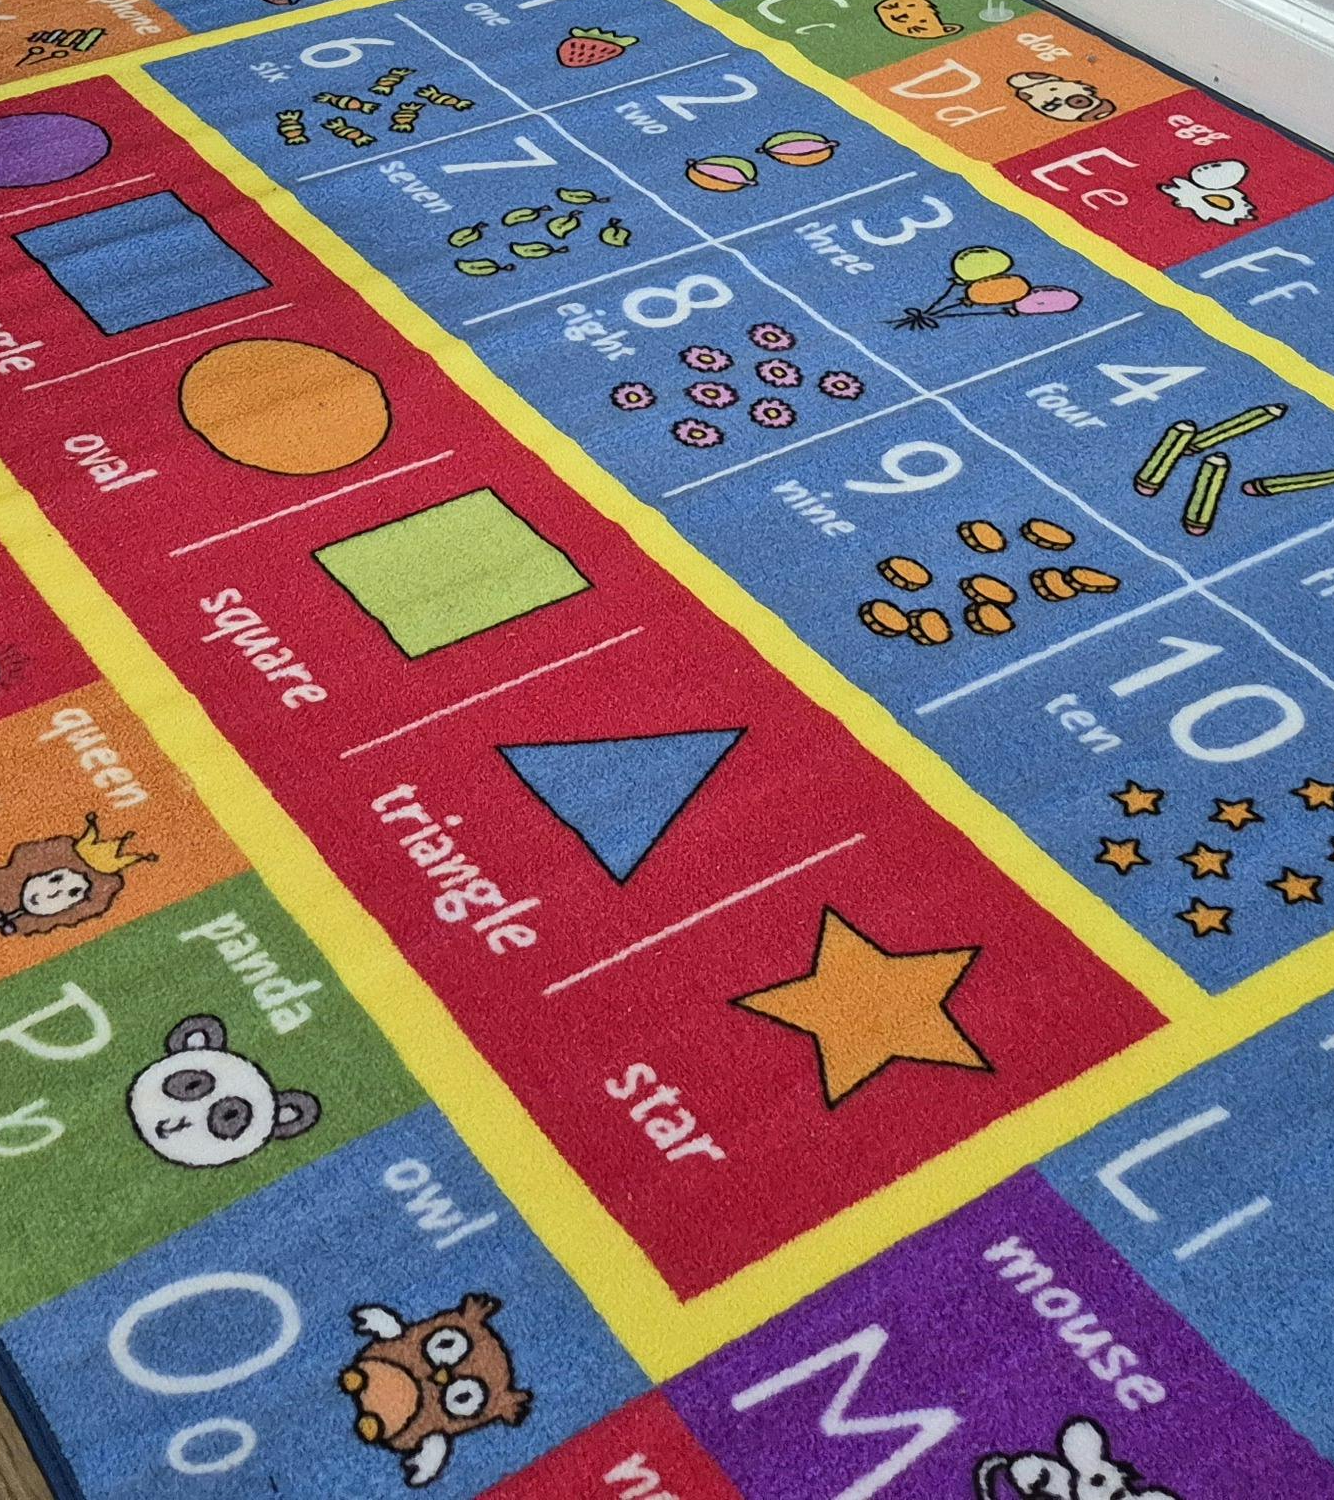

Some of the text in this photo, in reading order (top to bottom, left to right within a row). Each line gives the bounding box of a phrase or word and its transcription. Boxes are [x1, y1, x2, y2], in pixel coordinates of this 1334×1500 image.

[464, 1, 510, 28] one
[1015, 32, 1072, 63] dog
[614, 101, 668, 136] two
[1166, 110, 1231, 147] egg
[378, 158, 453, 215] seven
[794, 219, 875, 277] three
[557, 302, 636, 363] eight
[1025, 381, 1109, 430] four
[63, 432, 159, 492] oval
[770, 478, 856, 540] nine
[200, 586, 329, 710] square
[1046, 692, 1126, 754] ten
[36, 705, 150, 810] queen
[369, 783, 540, 955] triangle
[177, 910, 323, 1036] panda
[605, 1062, 727, 1162] star
[381, 1156, 500, 1251] owl
[982, 1232, 1168, 1412] mouse
